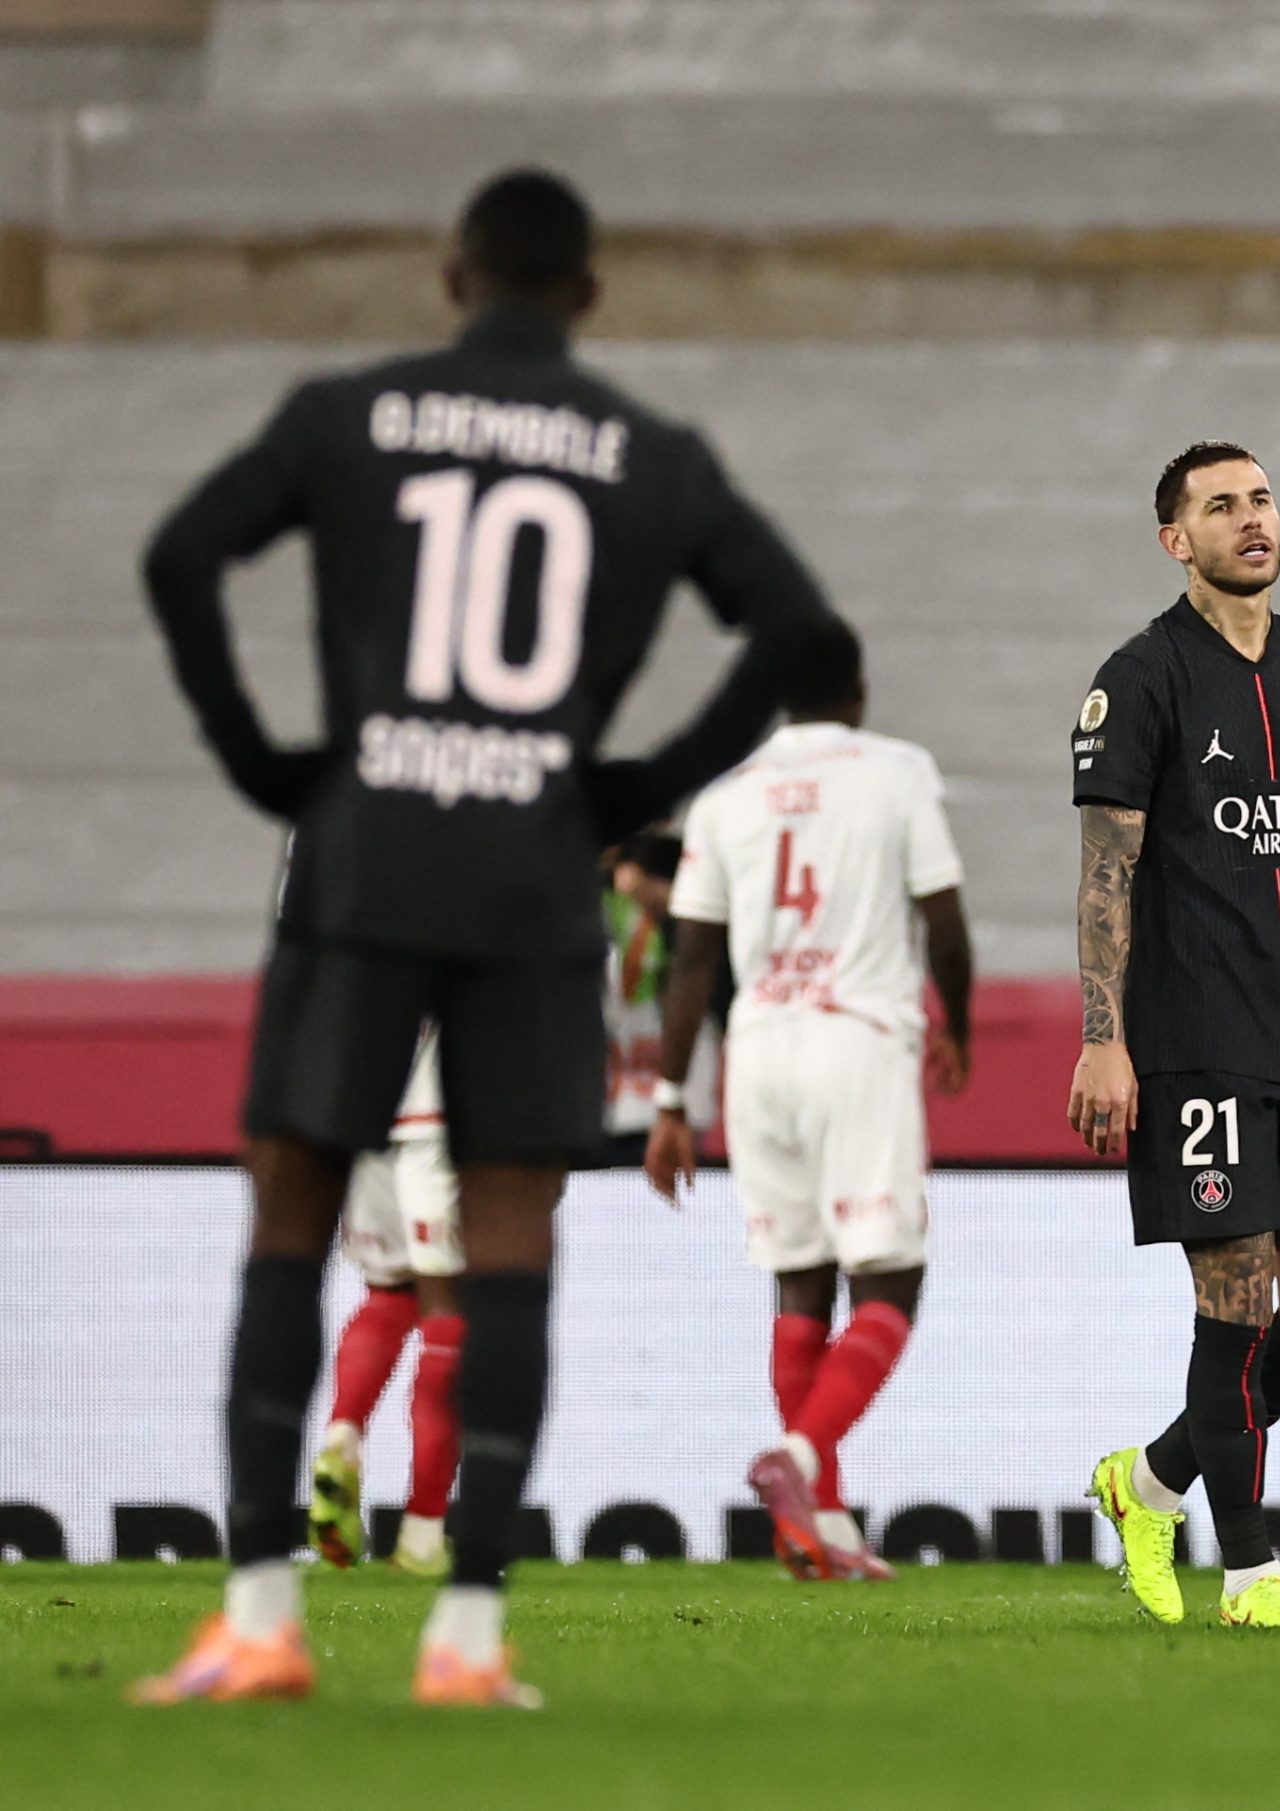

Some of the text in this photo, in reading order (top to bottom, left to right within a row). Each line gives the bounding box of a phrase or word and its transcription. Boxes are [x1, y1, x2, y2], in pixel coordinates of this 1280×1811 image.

[396, 467, 594, 714] 10
[774, 830, 821, 930] 4
[1181, 1097, 1239, 1166] 21
